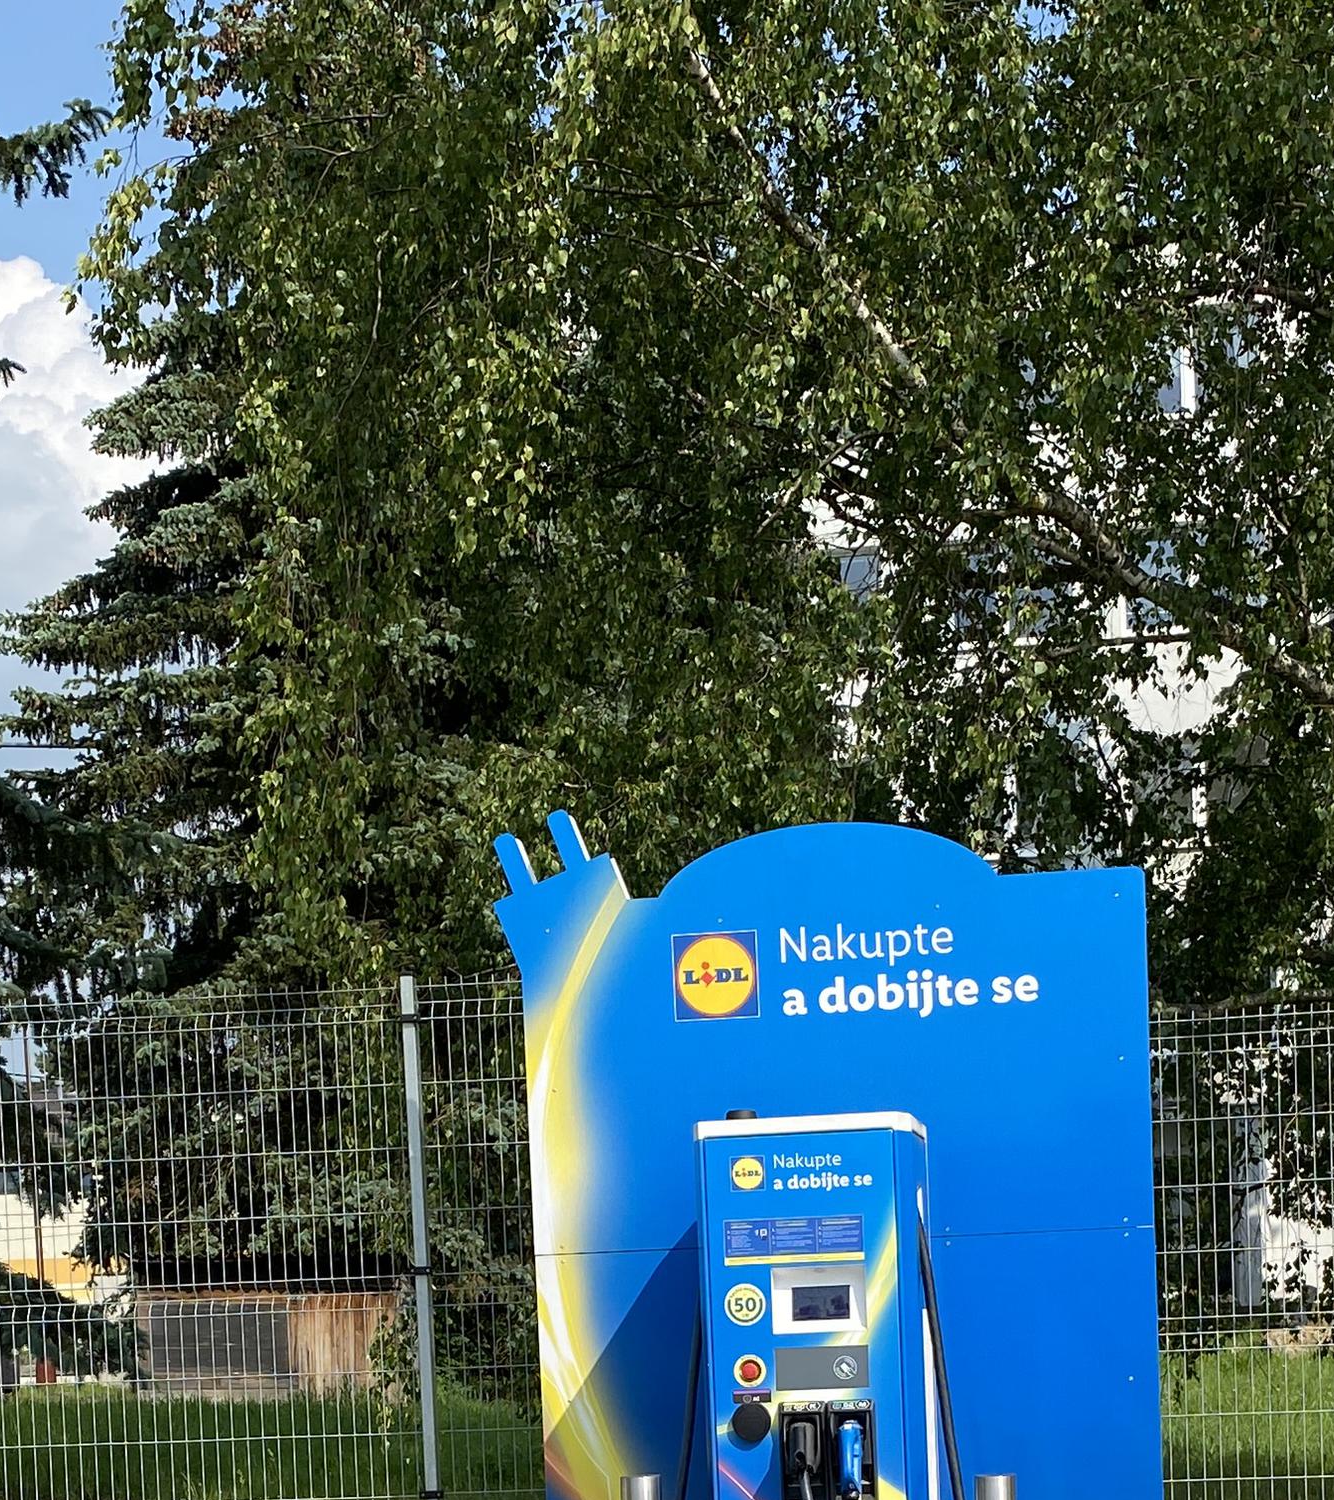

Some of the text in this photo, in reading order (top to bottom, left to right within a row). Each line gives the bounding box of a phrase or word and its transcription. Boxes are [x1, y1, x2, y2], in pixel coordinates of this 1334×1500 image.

[779, 923, 954, 967] Nakupte
[782, 968, 1039, 1018] a dobijte se
[773, 1152, 842, 1171] Nakupte
[773, 1172, 873, 1191] a dobijte se
[734, 1297, 757, 1313] 50
